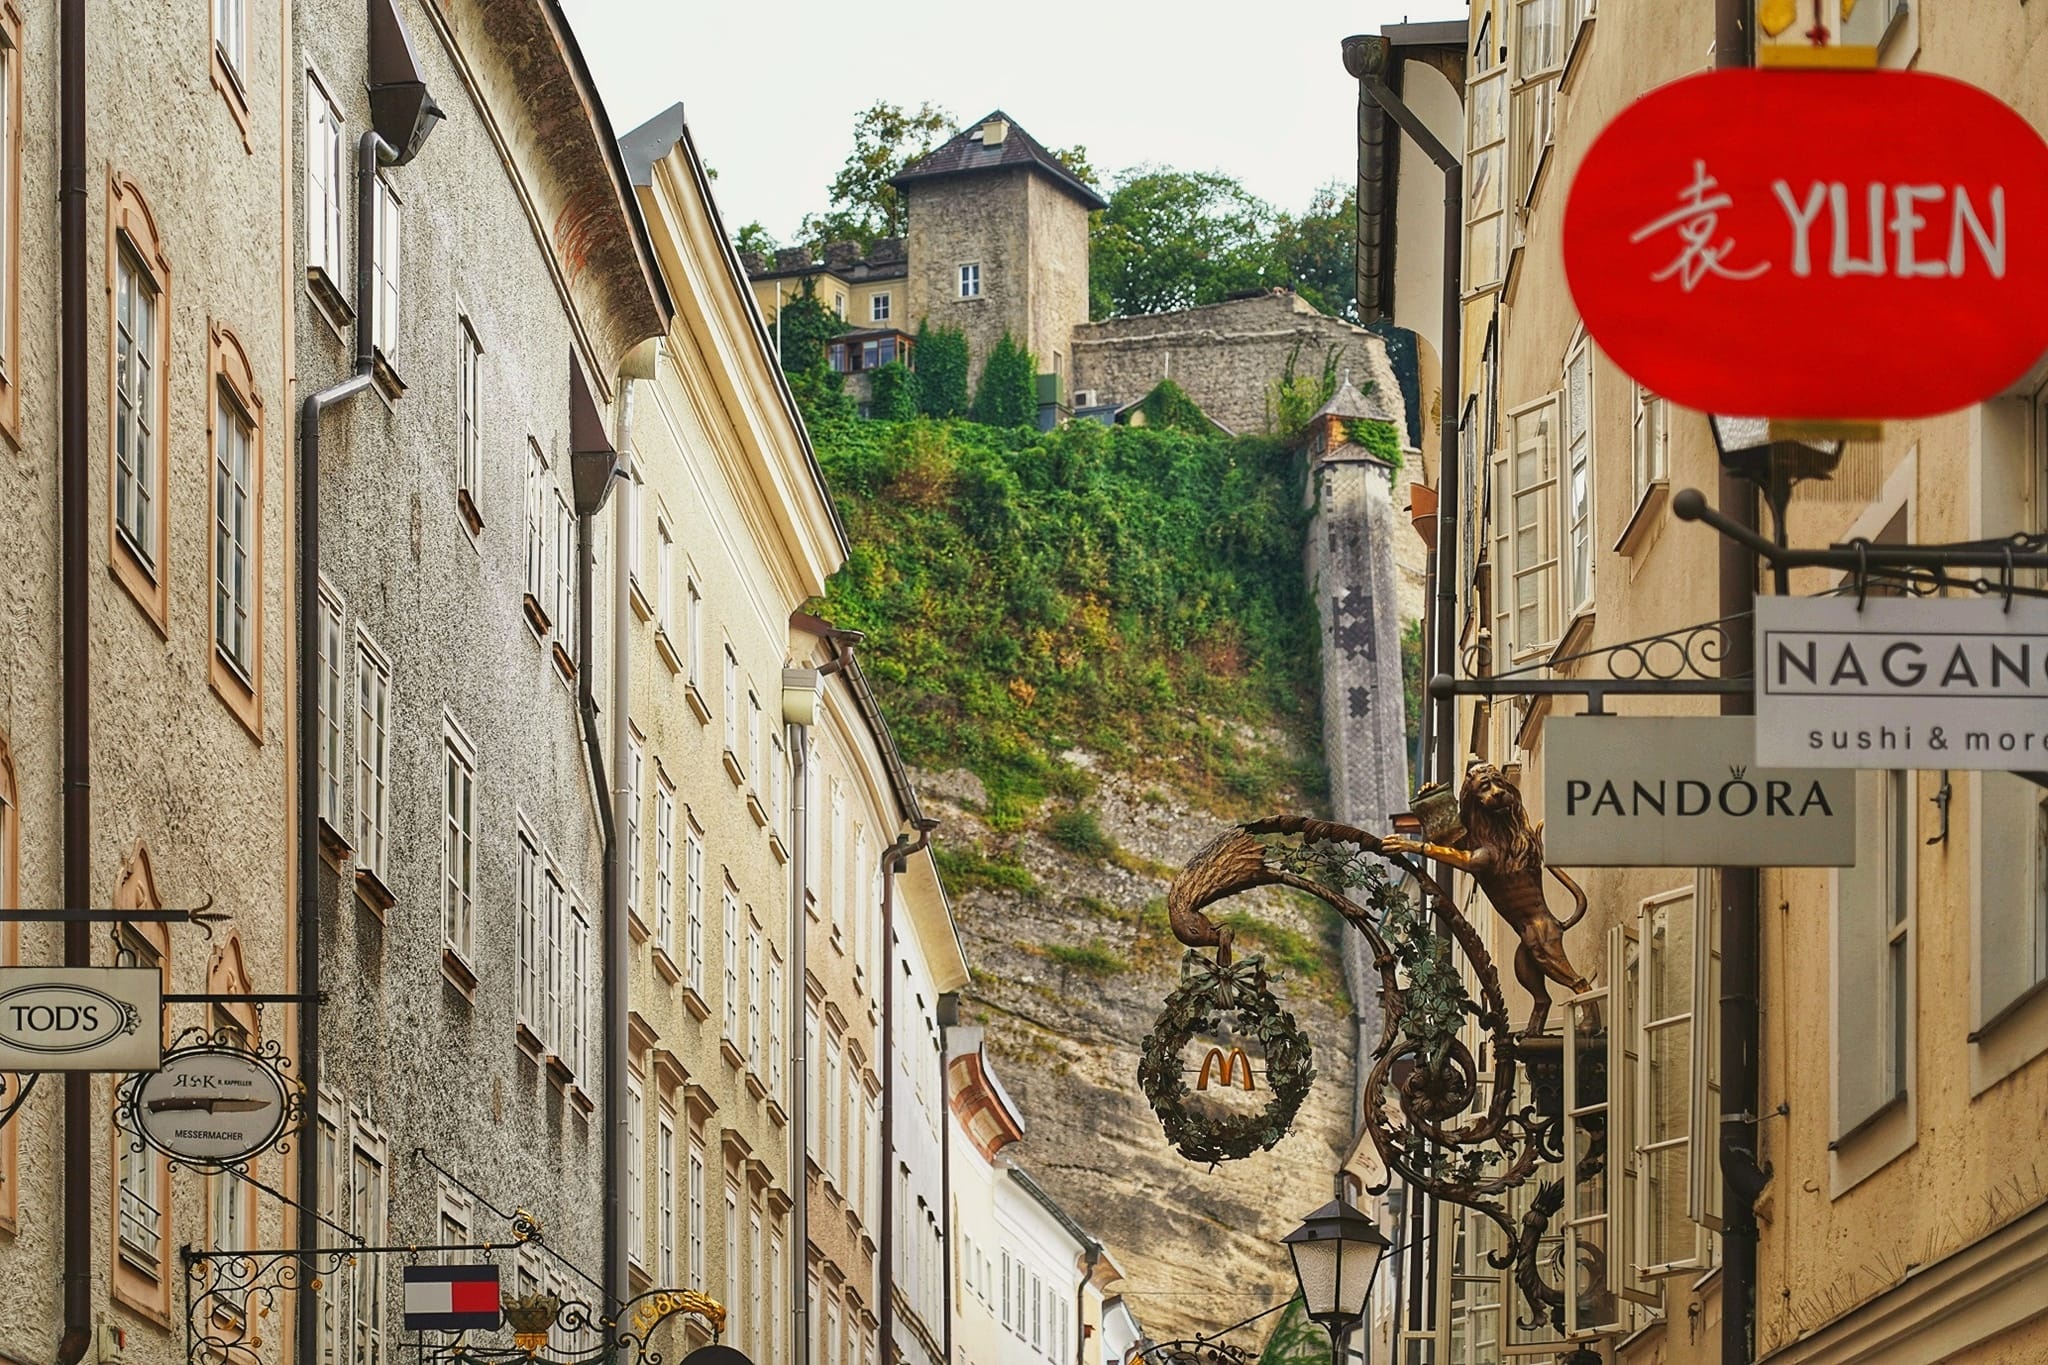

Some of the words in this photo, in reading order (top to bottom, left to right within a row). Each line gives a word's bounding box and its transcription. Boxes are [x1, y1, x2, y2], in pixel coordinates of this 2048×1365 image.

[1771, 179, 2006, 280] YUEN
[1777, 641, 2048, 689] NAGAN
[1809, 726, 1911, 750] sushi
[1929, 727, 1948, 750] &
[1566, 779, 1833, 817] PANDORA
[9, 1005, 98, 1032] TOD'S
[174, 1130, 243, 1140] MESSERMACHER
